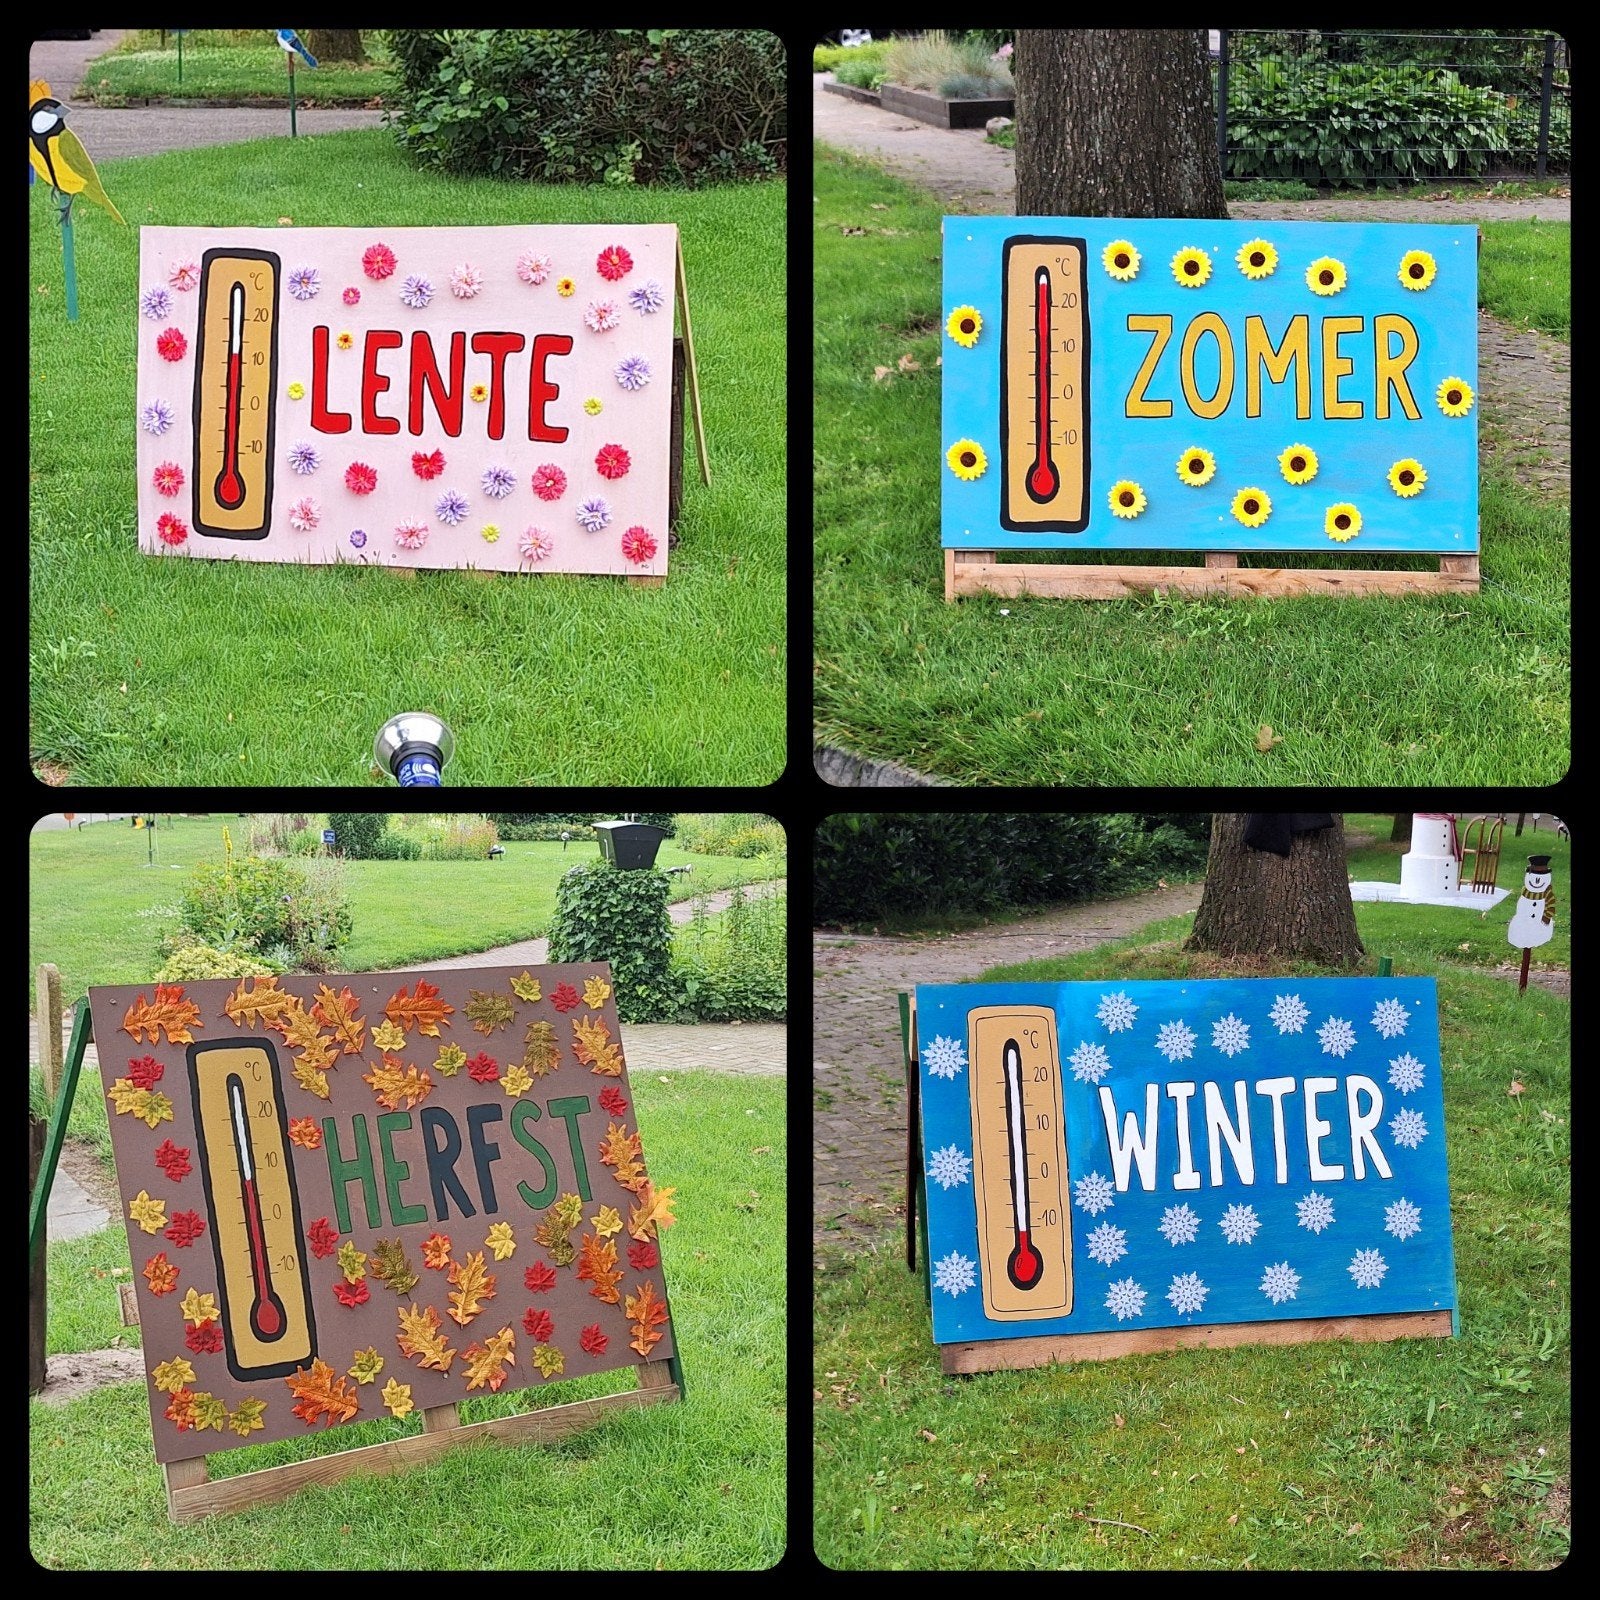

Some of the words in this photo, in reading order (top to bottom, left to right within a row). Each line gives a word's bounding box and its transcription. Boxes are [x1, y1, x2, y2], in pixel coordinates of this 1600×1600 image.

[1061, 292, 1078, 309] 20
[253, 307, 269, 323] 20
[1061, 338, 1076, 354] 10
[252, 352, 265, 366] 10
[1124, 311, 1423, 421] ZOMER
[310, 325, 574, 444] LENTE
[1063, 384, 1073, 400] 0
[250, 396, 260, 411] 0
[1056, 428, 1078, 445] -10
[245, 440, 263, 454] -10
[1033, 1066, 1048, 1083] 20
[257, 1101, 273, 1118] 20
[1036, 1114, 1050, 1131] 10
[1097, 1073, 1393, 1193] WINTER
[264, 1151, 278, 1168] 10
[321, 1094, 593, 1234] HERFST
[1041, 1162, 1049, 1179] 0
[272, 1203, 282, 1219] 0
[1037, 1209, 1057, 1227] -10
[276, 1254, 295, 1272] -10
